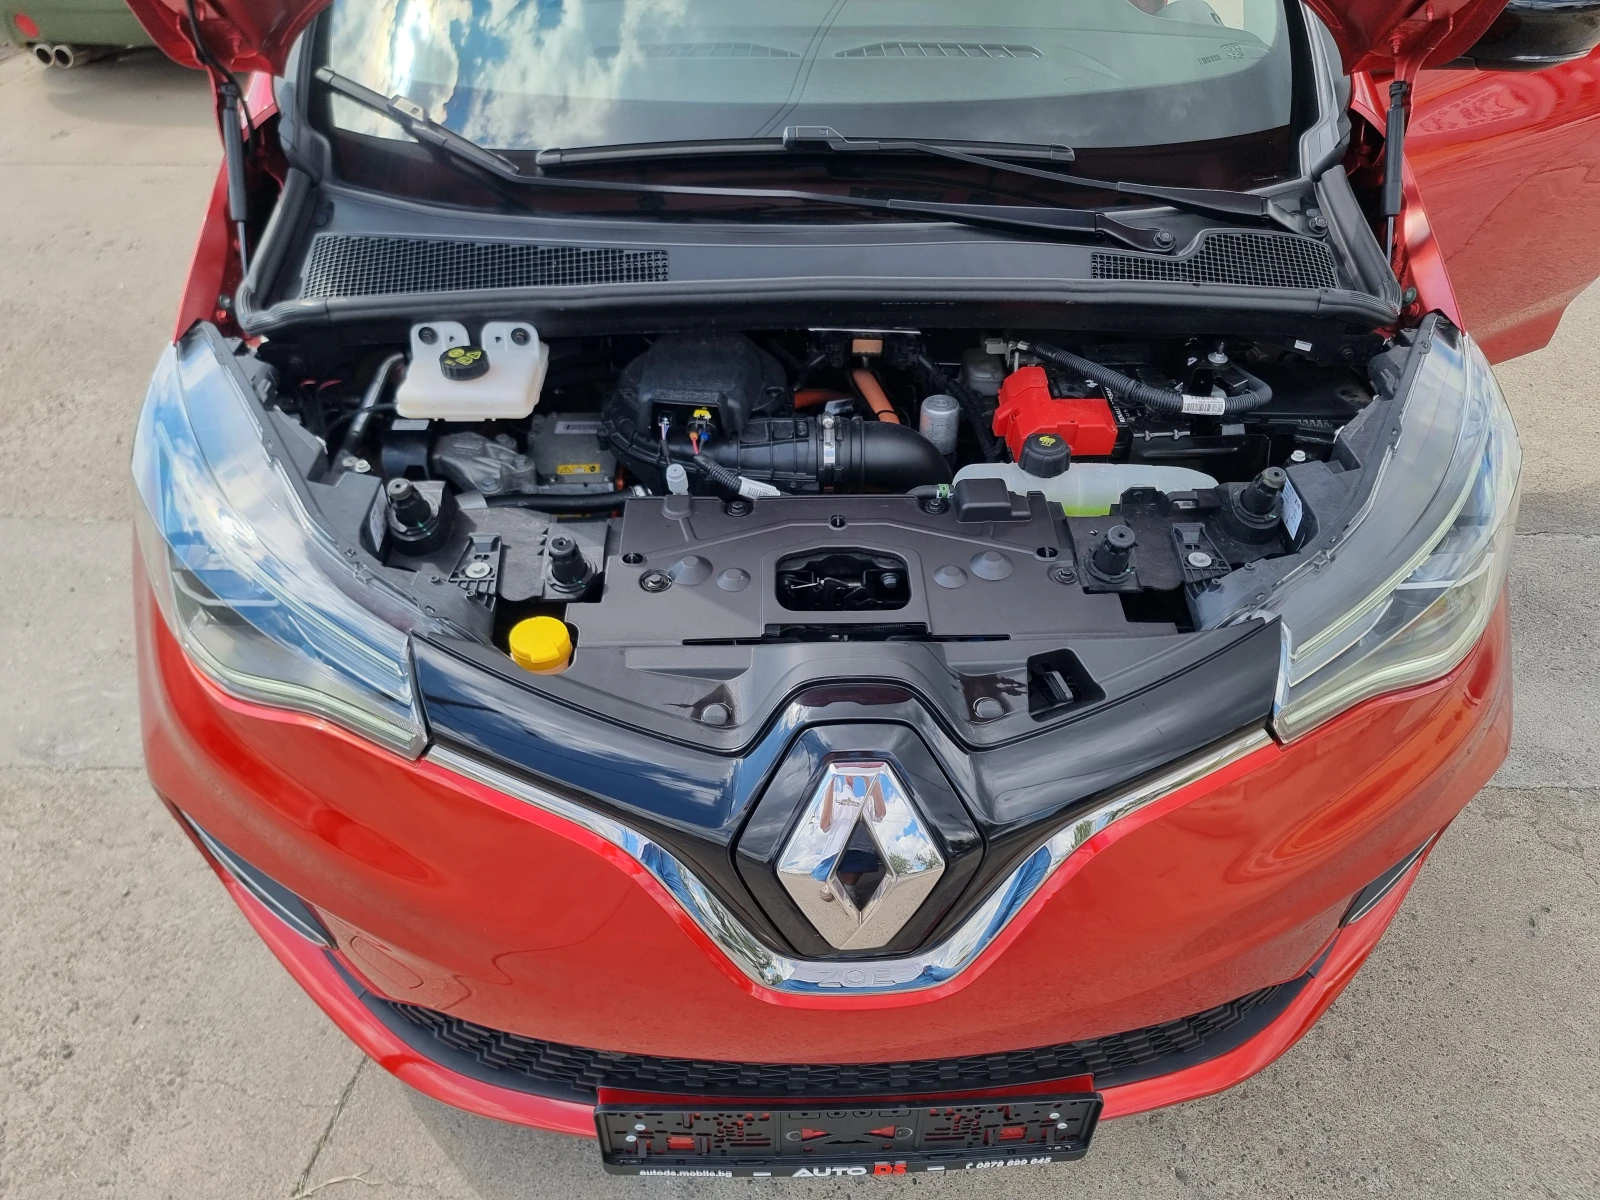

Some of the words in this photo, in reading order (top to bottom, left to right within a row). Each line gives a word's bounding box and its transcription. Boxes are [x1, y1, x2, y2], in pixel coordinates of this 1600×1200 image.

[817, 968, 896, 988] ZOE
[792, 1165, 868, 1178] AUTO
[873, 1161, 907, 1176] DS
